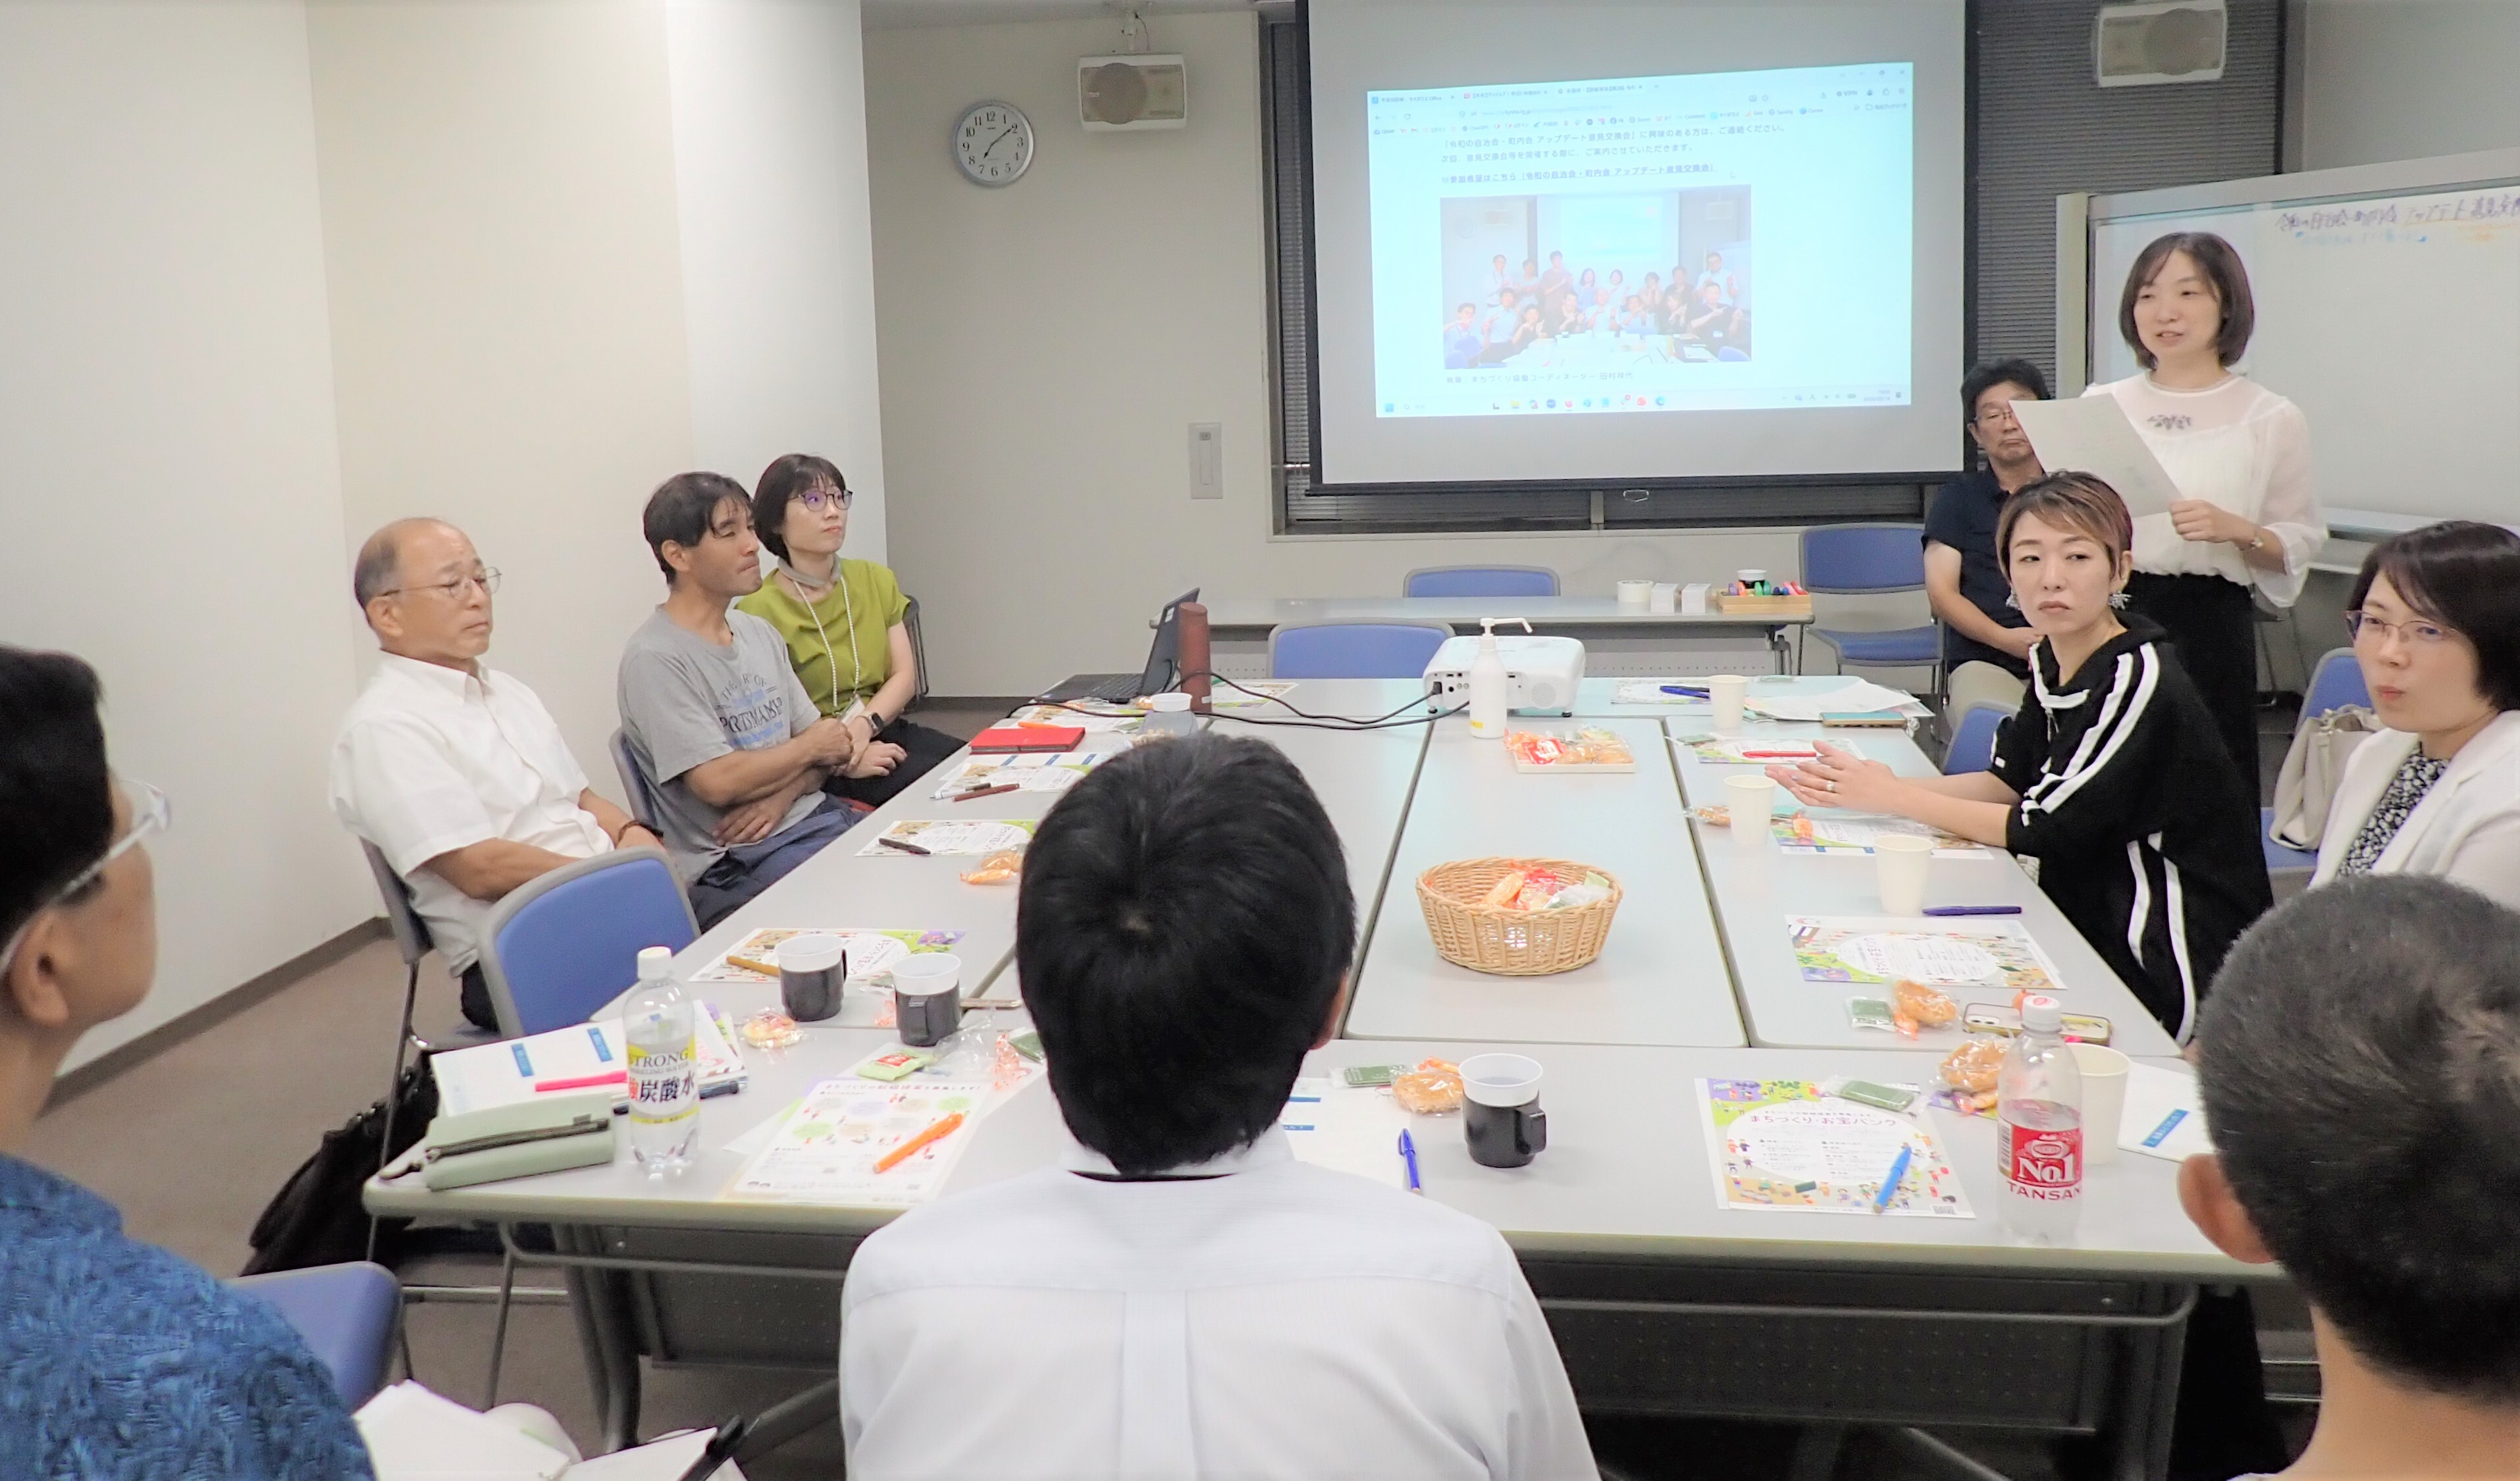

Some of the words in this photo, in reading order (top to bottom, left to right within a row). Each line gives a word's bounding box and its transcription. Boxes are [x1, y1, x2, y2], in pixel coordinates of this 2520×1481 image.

[974, 115, 982, 126] 11
[987, 111, 996, 122] 12
[1003, 114, 1007, 124] 1
[966, 126, 976, 138] 10
[1011, 123, 1018, 134] 2
[962, 142, 970, 152] 9
[1017, 137, 1024, 147] 3
[968, 155, 976, 165] 8
[978, 165, 985, 174] 7
[991, 166, 999, 177] 6
[1005, 163, 1011, 173] 5
